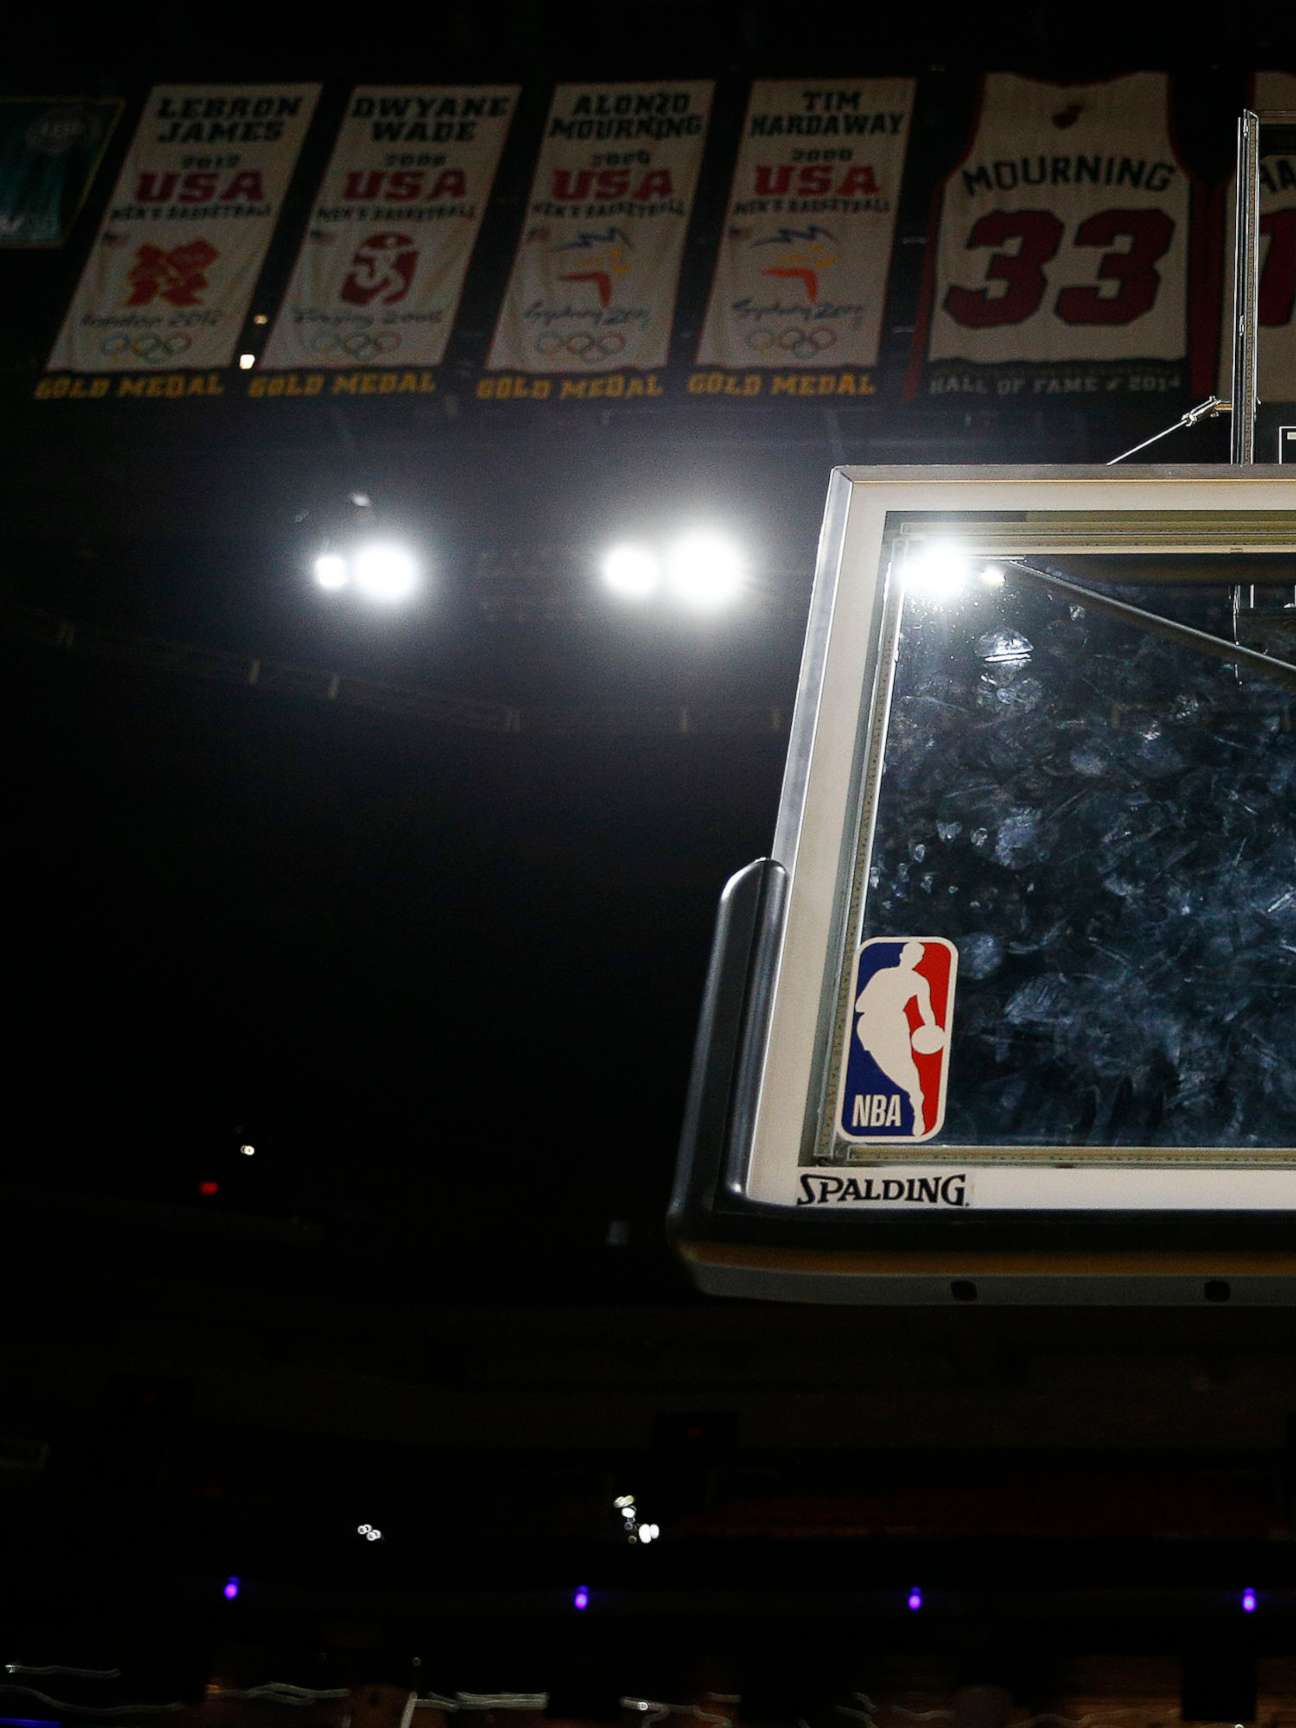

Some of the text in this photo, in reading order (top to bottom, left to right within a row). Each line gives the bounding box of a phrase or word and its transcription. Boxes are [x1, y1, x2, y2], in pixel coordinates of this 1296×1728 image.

[157, 97, 302, 118] LEBRON
[352, 97, 511, 118] DWYANE
[573, 92, 690, 116] ALONZO
[803, 91, 861, 111] TIM
[157, 120, 285, 143] JAMES
[372, 121, 478, 142] WADE
[551, 115, 703, 140] MOURNING
[750, 112, 904, 137] HARDAWAY
[137, 170, 264, 204] USA
[344, 168, 466, 201] USA
[552, 168, 673, 201] USA
[754, 165, 881, 197] USA
[963, 154, 1176, 196] MOURNING
[943, 209, 1177, 329] 33
[33, 372, 225, 400] GOLD MEDAL
[247, 370, 437, 398] GOLD MEDAL
[475, 372, 664, 400] GOLD MEDAL
[687, 371, 876, 397] GOLD MEDAL
[929, 375, 987, 395] HALL
[997, 376, 1026, 395] OF
[1032, 376, 1098, 393] FAME
[851, 1093, 902, 1128] NBA
[796, 1173, 968, 1207] SPALDING
